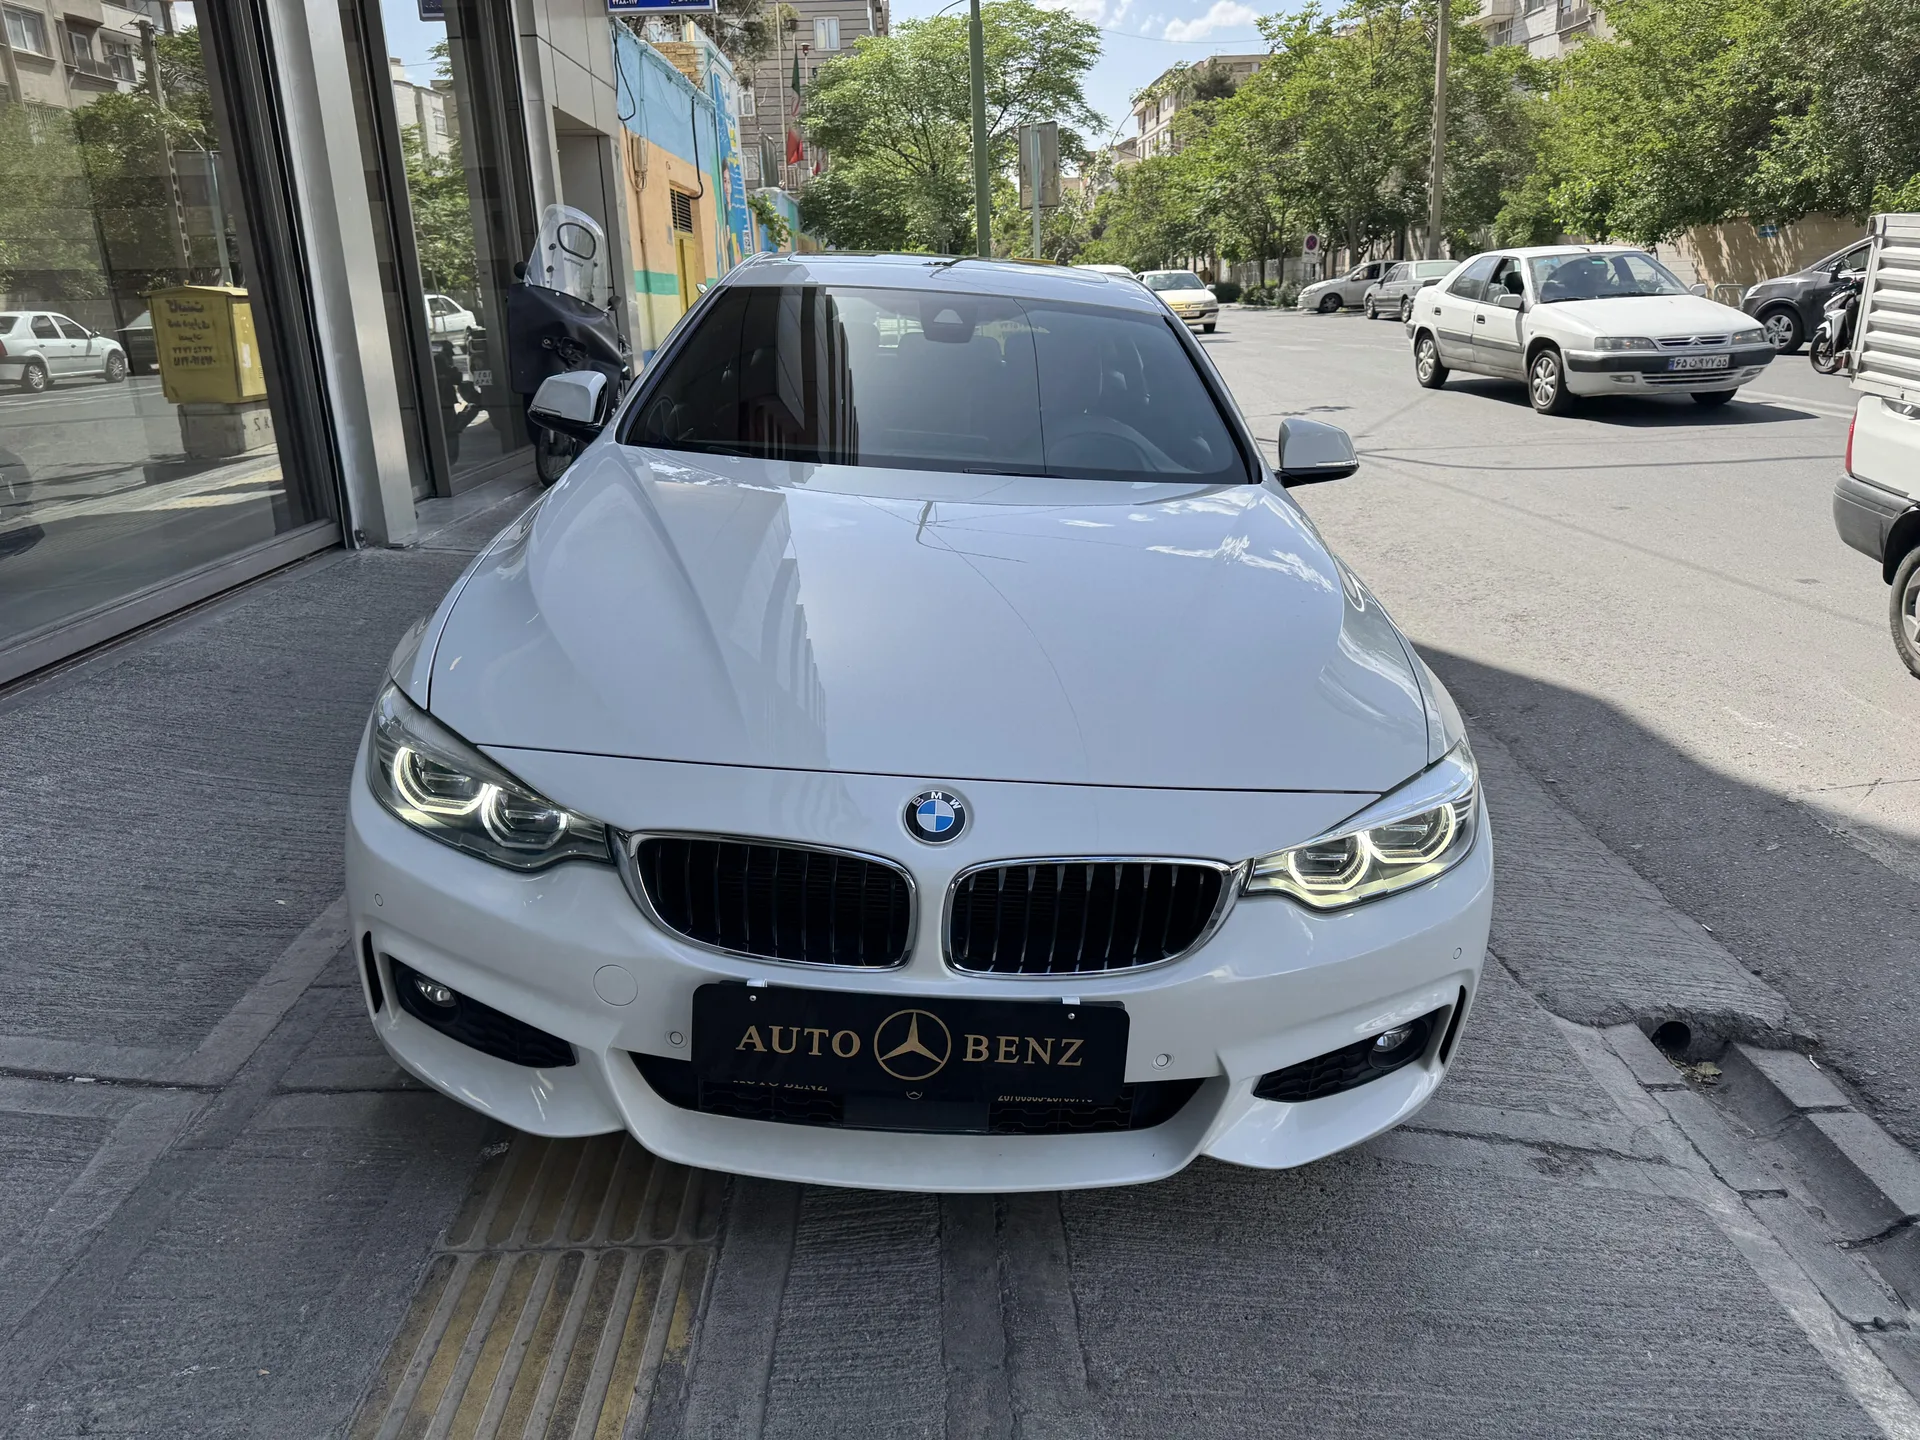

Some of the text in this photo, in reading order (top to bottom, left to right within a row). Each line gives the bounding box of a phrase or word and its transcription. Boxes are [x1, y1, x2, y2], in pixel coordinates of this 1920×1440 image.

[911, 791, 962, 810] BMW
[735, 1025, 1085, 1067] AUTO BENZ
